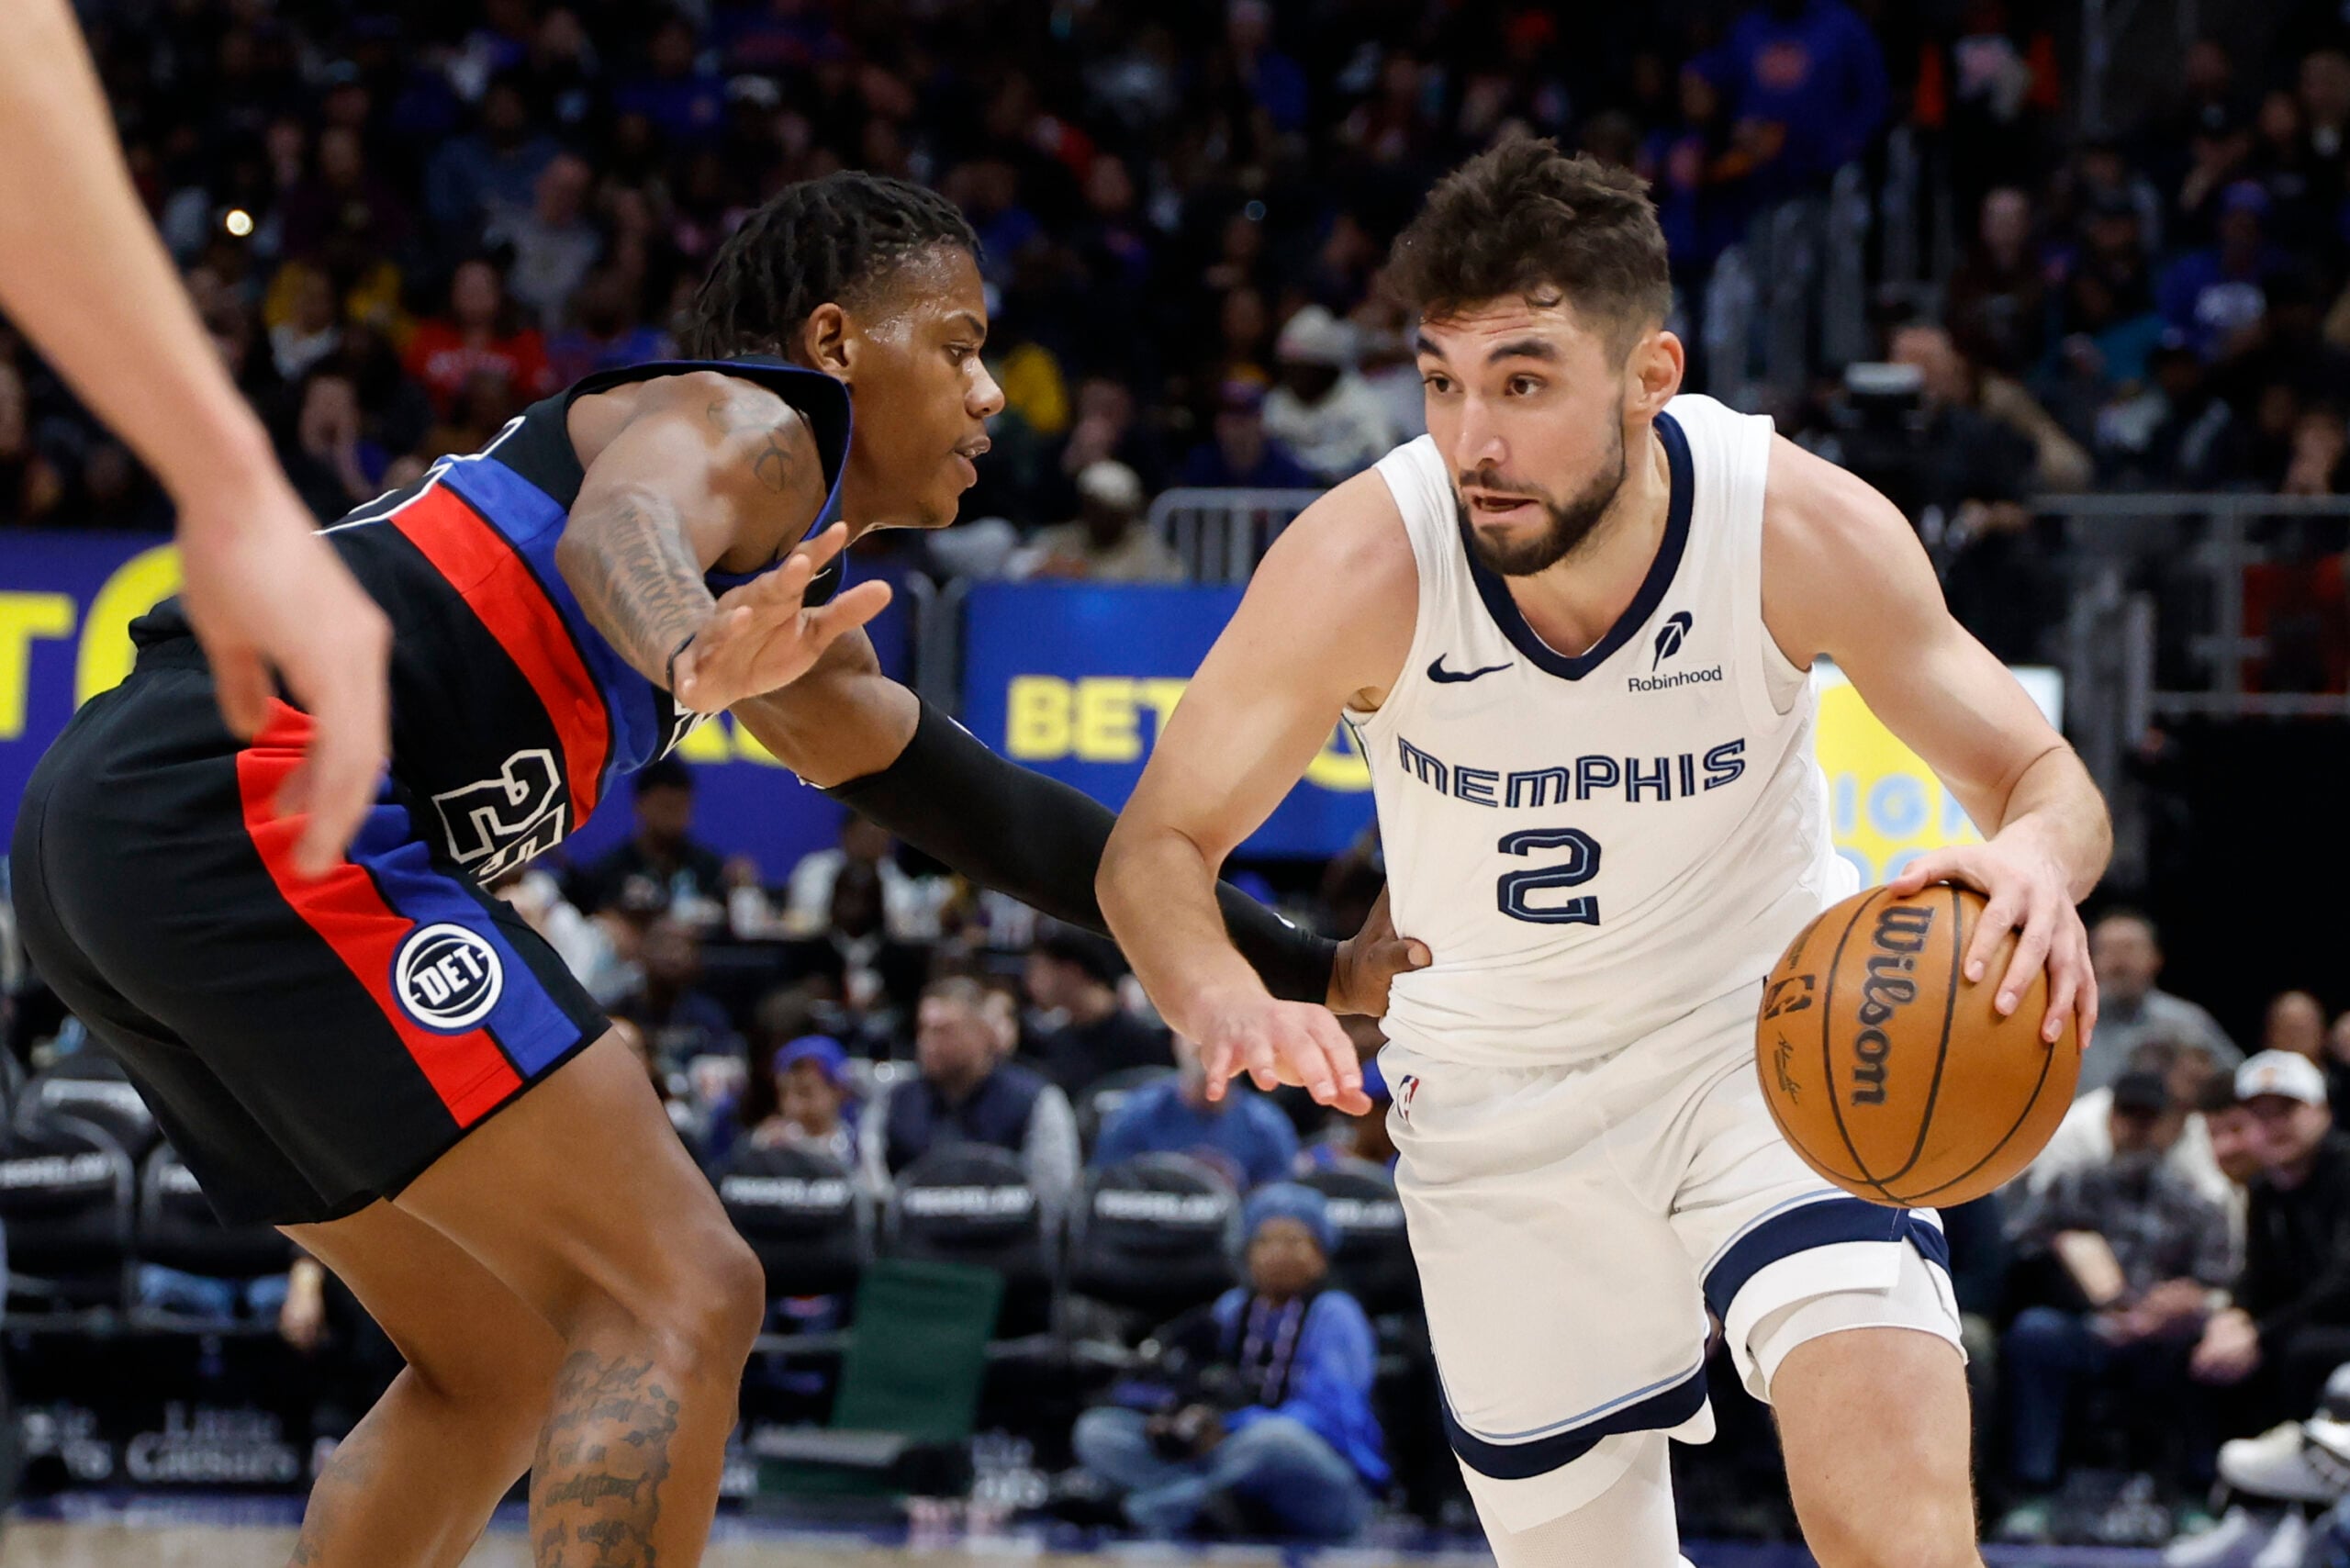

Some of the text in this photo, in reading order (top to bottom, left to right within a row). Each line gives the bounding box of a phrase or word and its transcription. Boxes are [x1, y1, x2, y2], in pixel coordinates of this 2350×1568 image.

[1628, 665, 1723, 693] Robinhood
[1396, 733, 1746, 809] MEMPHIS
[1497, 827, 1602, 925] 2
[411, 944, 484, 1007] DET
[1851, 904, 1936, 1107] Wilson
